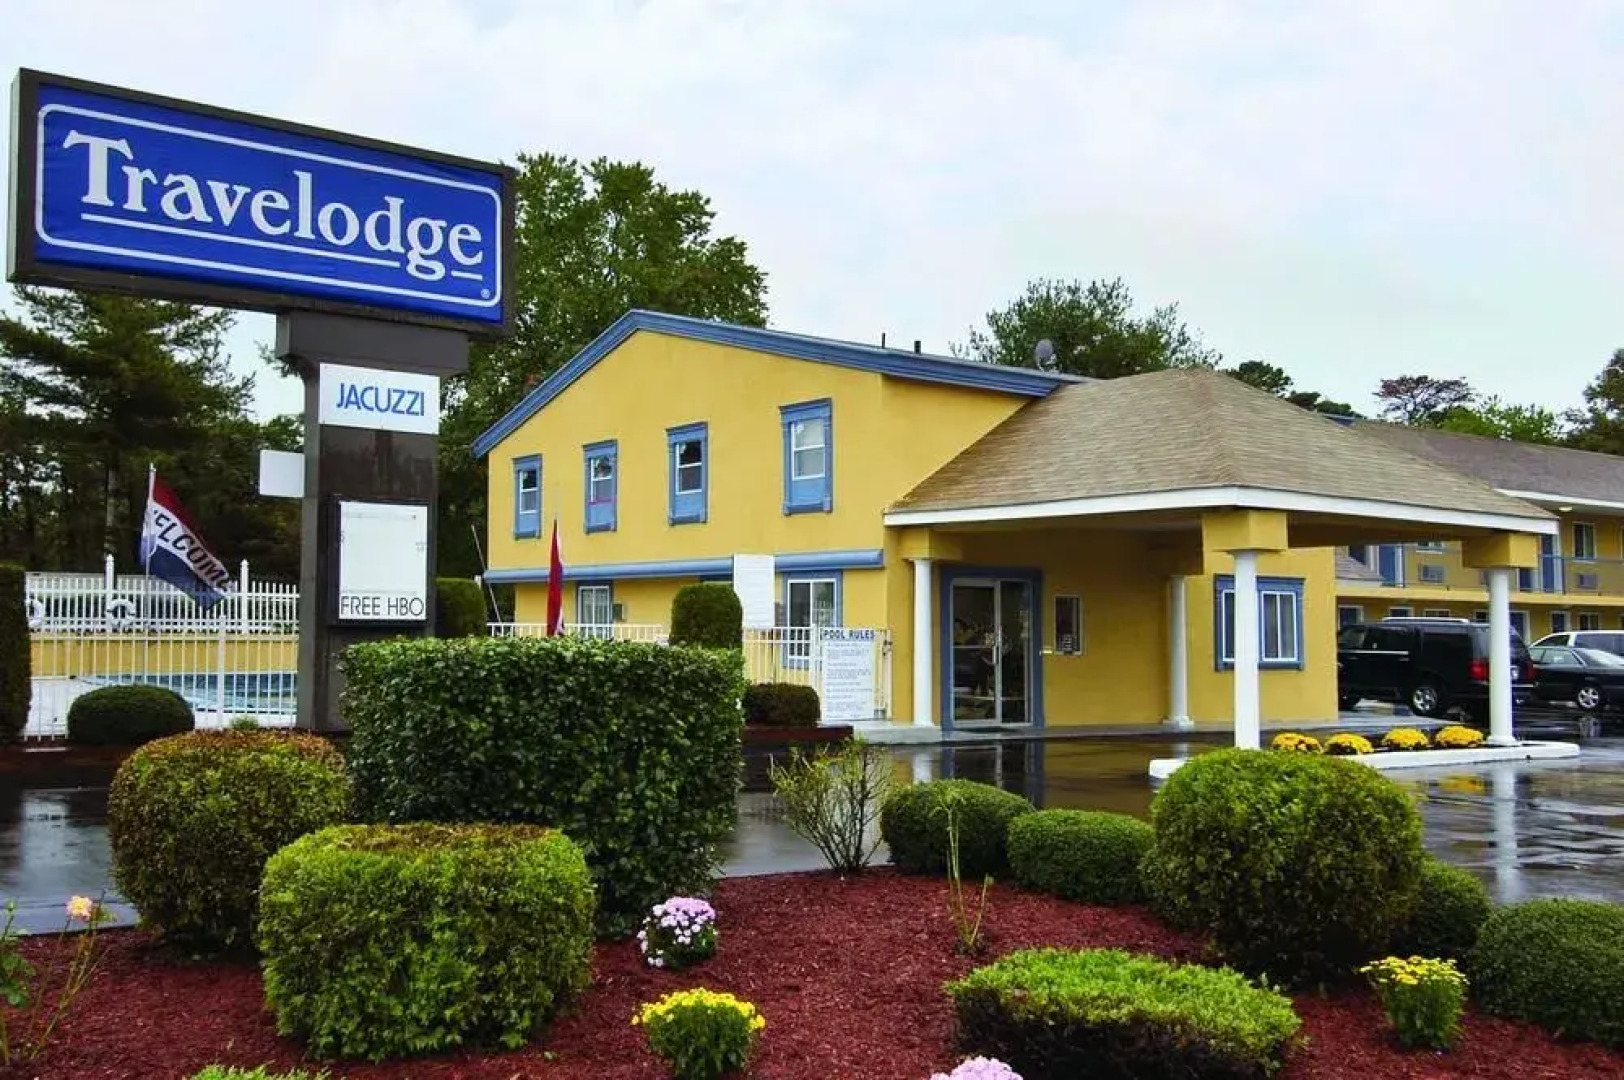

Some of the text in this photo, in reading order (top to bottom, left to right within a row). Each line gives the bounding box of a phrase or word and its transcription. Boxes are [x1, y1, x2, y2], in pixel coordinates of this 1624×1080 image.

[62, 129, 483, 280] Travelodge
[336, 383, 425, 416] JACUZZI
[153, 509, 228, 588] ELCOM
[340, 596, 424, 617] FREE HBO
[824, 629, 875, 639] POOL RULES
